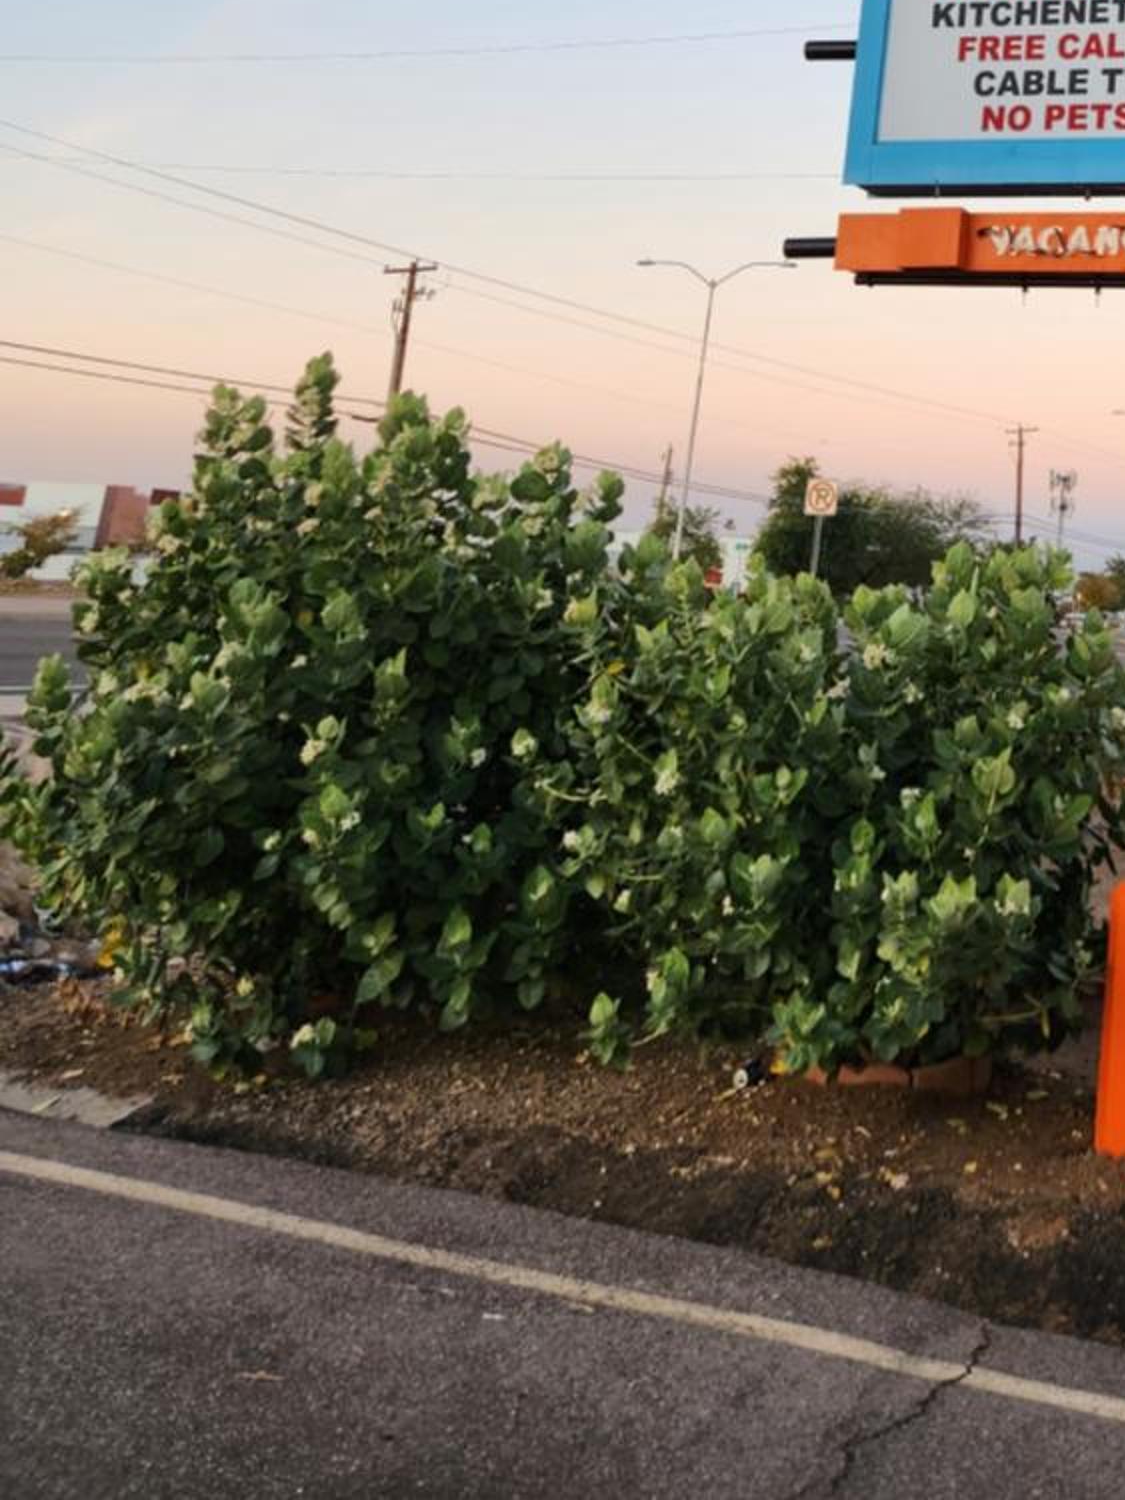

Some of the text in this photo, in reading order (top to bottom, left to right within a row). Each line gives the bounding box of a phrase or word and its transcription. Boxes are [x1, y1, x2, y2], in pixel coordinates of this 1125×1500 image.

[958, 35, 1045, 62] FREE
[973, 69, 1089, 97] CABLE
[981, 106, 1031, 131] NO
